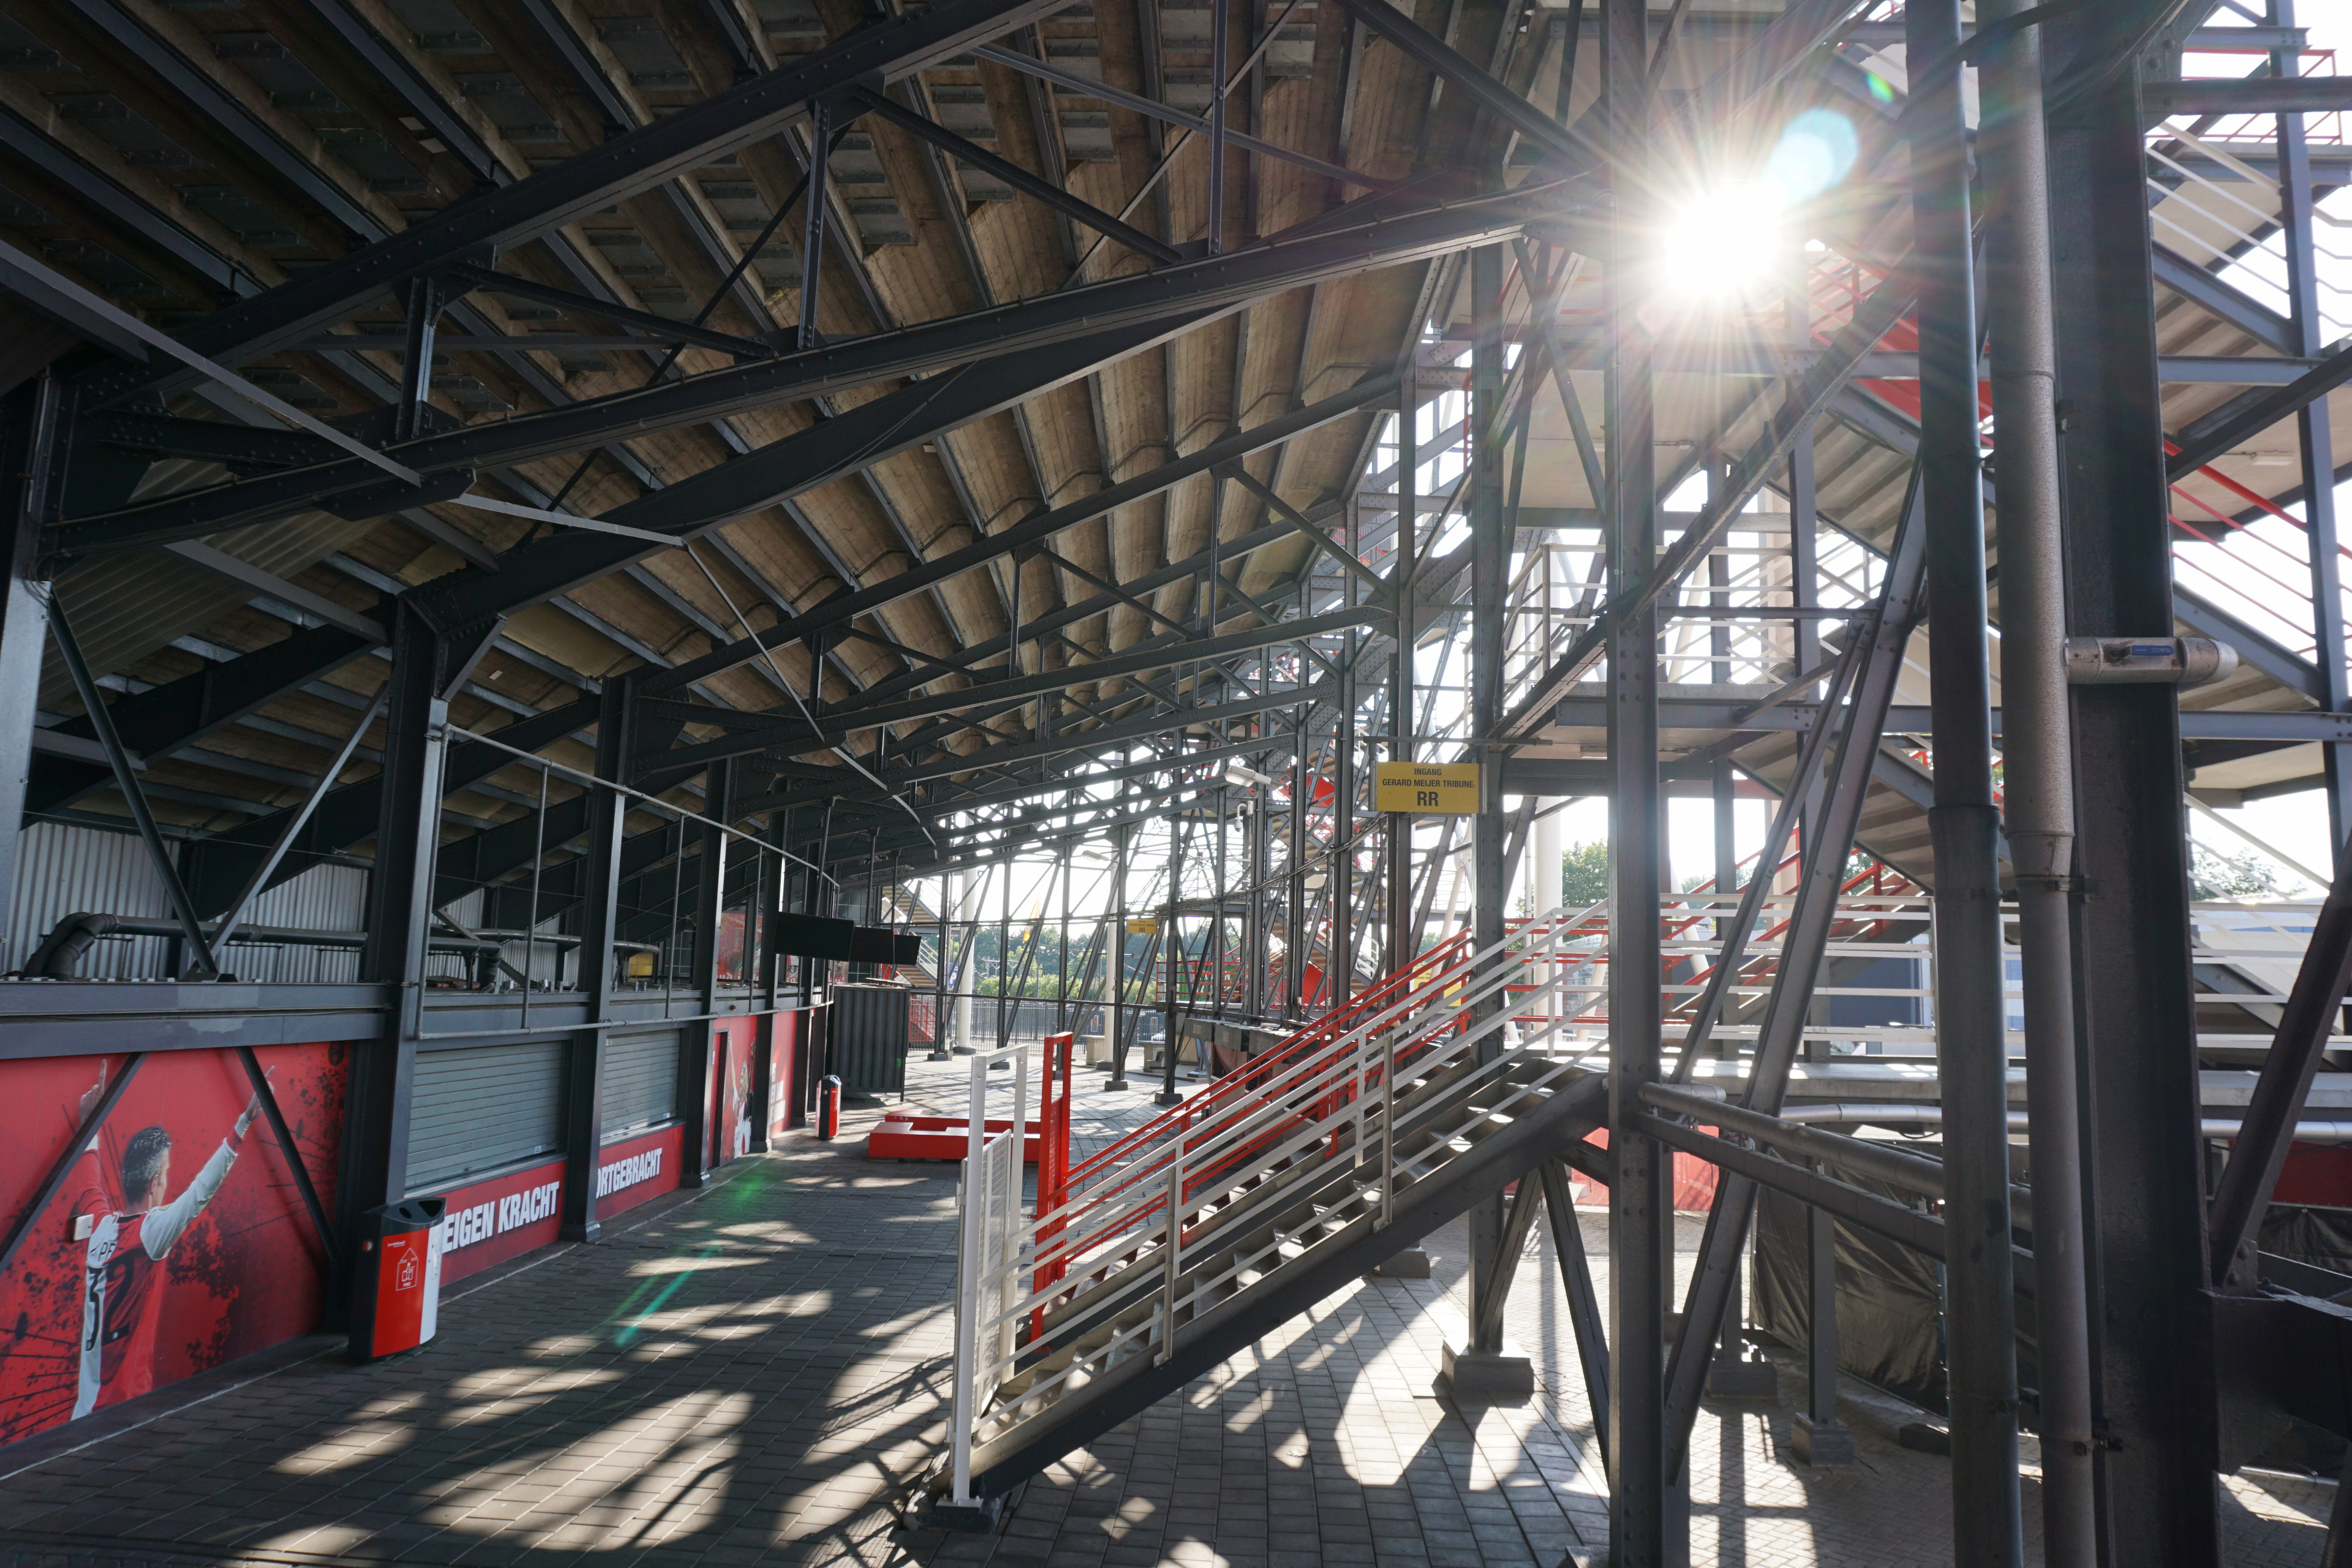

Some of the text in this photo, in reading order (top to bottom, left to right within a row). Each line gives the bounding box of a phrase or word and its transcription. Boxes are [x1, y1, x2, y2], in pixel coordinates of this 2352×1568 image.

[1417, 791, 1439, 807] RR
[442, 1181, 560, 1254] EIGEN KRACHT
